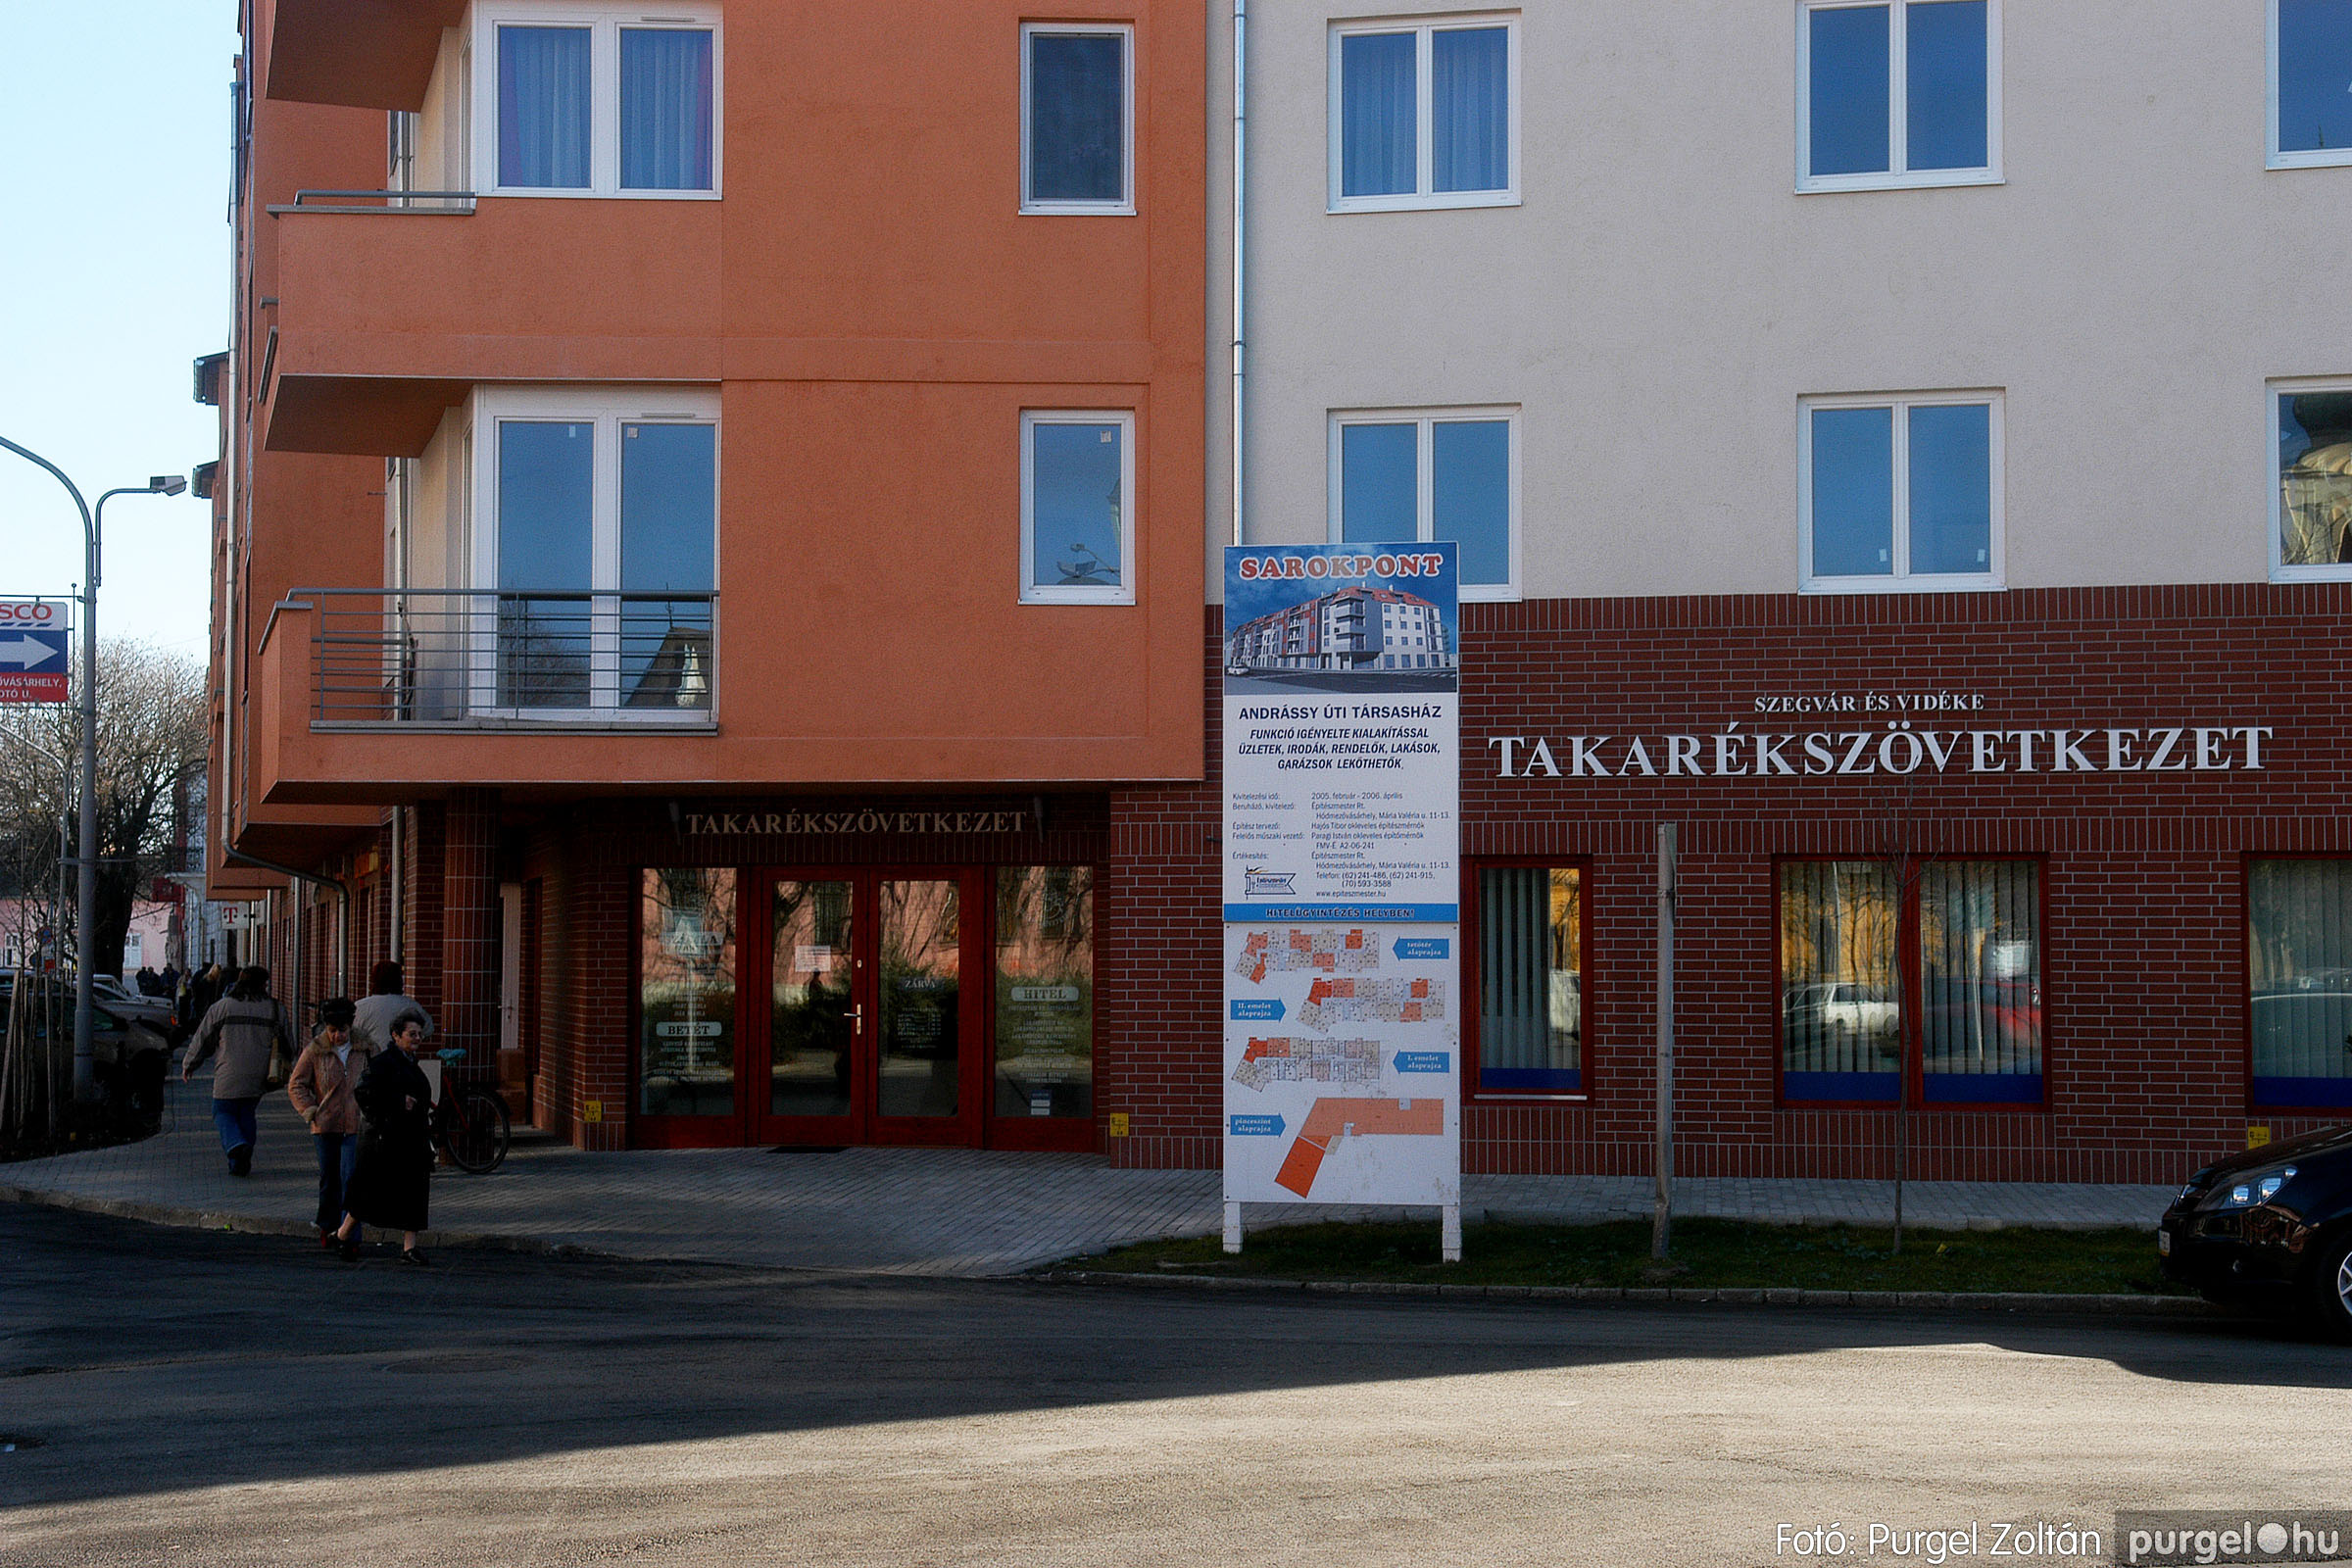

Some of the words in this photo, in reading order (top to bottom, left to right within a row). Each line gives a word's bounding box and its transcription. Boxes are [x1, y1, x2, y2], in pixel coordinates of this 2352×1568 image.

[1240, 554, 1443, 579] SAROKPONT
[0, 675, 62, 688] VÁSÁRHELY,
[1754, 692, 1856, 712] SZEGVÁR
[1865, 691, 1890, 711] ÉS
[1896, 690, 1984, 710] VIDÉKE
[1239, 704, 1319, 719] ANDRÁSSY
[1323, 704, 1347, 719] ÚTI
[1351, 703, 1442, 719] TÁRSASHÁZ
[1250, 727, 1295, 740] FUNKCIÓ
[1297, 726, 1350, 739] IGÉNYELTE
[1352, 725, 1429, 739] KIALAKÍTÁSSAL
[1239, 743, 1285, 757] ÜZLETEK,
[1287, 742, 1329, 756] IRODÁK,
[1331, 742, 1389, 755] RENDELŐK,
[1391, 740, 1441, 754] LAKÁSOK,
[1488, 720, 2273, 777] TAKARÉKSZÖVETKEZET
[1277, 757, 1333, 770] GARÁZSOK
[686, 808, 1027, 835] TAKARÉKSZÖVETKEZET
[1364, 907, 1415, 918] HELYBEN!
[905, 978, 936, 989] ZÁRVA
[1024, 989, 1067, 1000] HITEL
[667, 1021, 710, 1035] BETÉT
